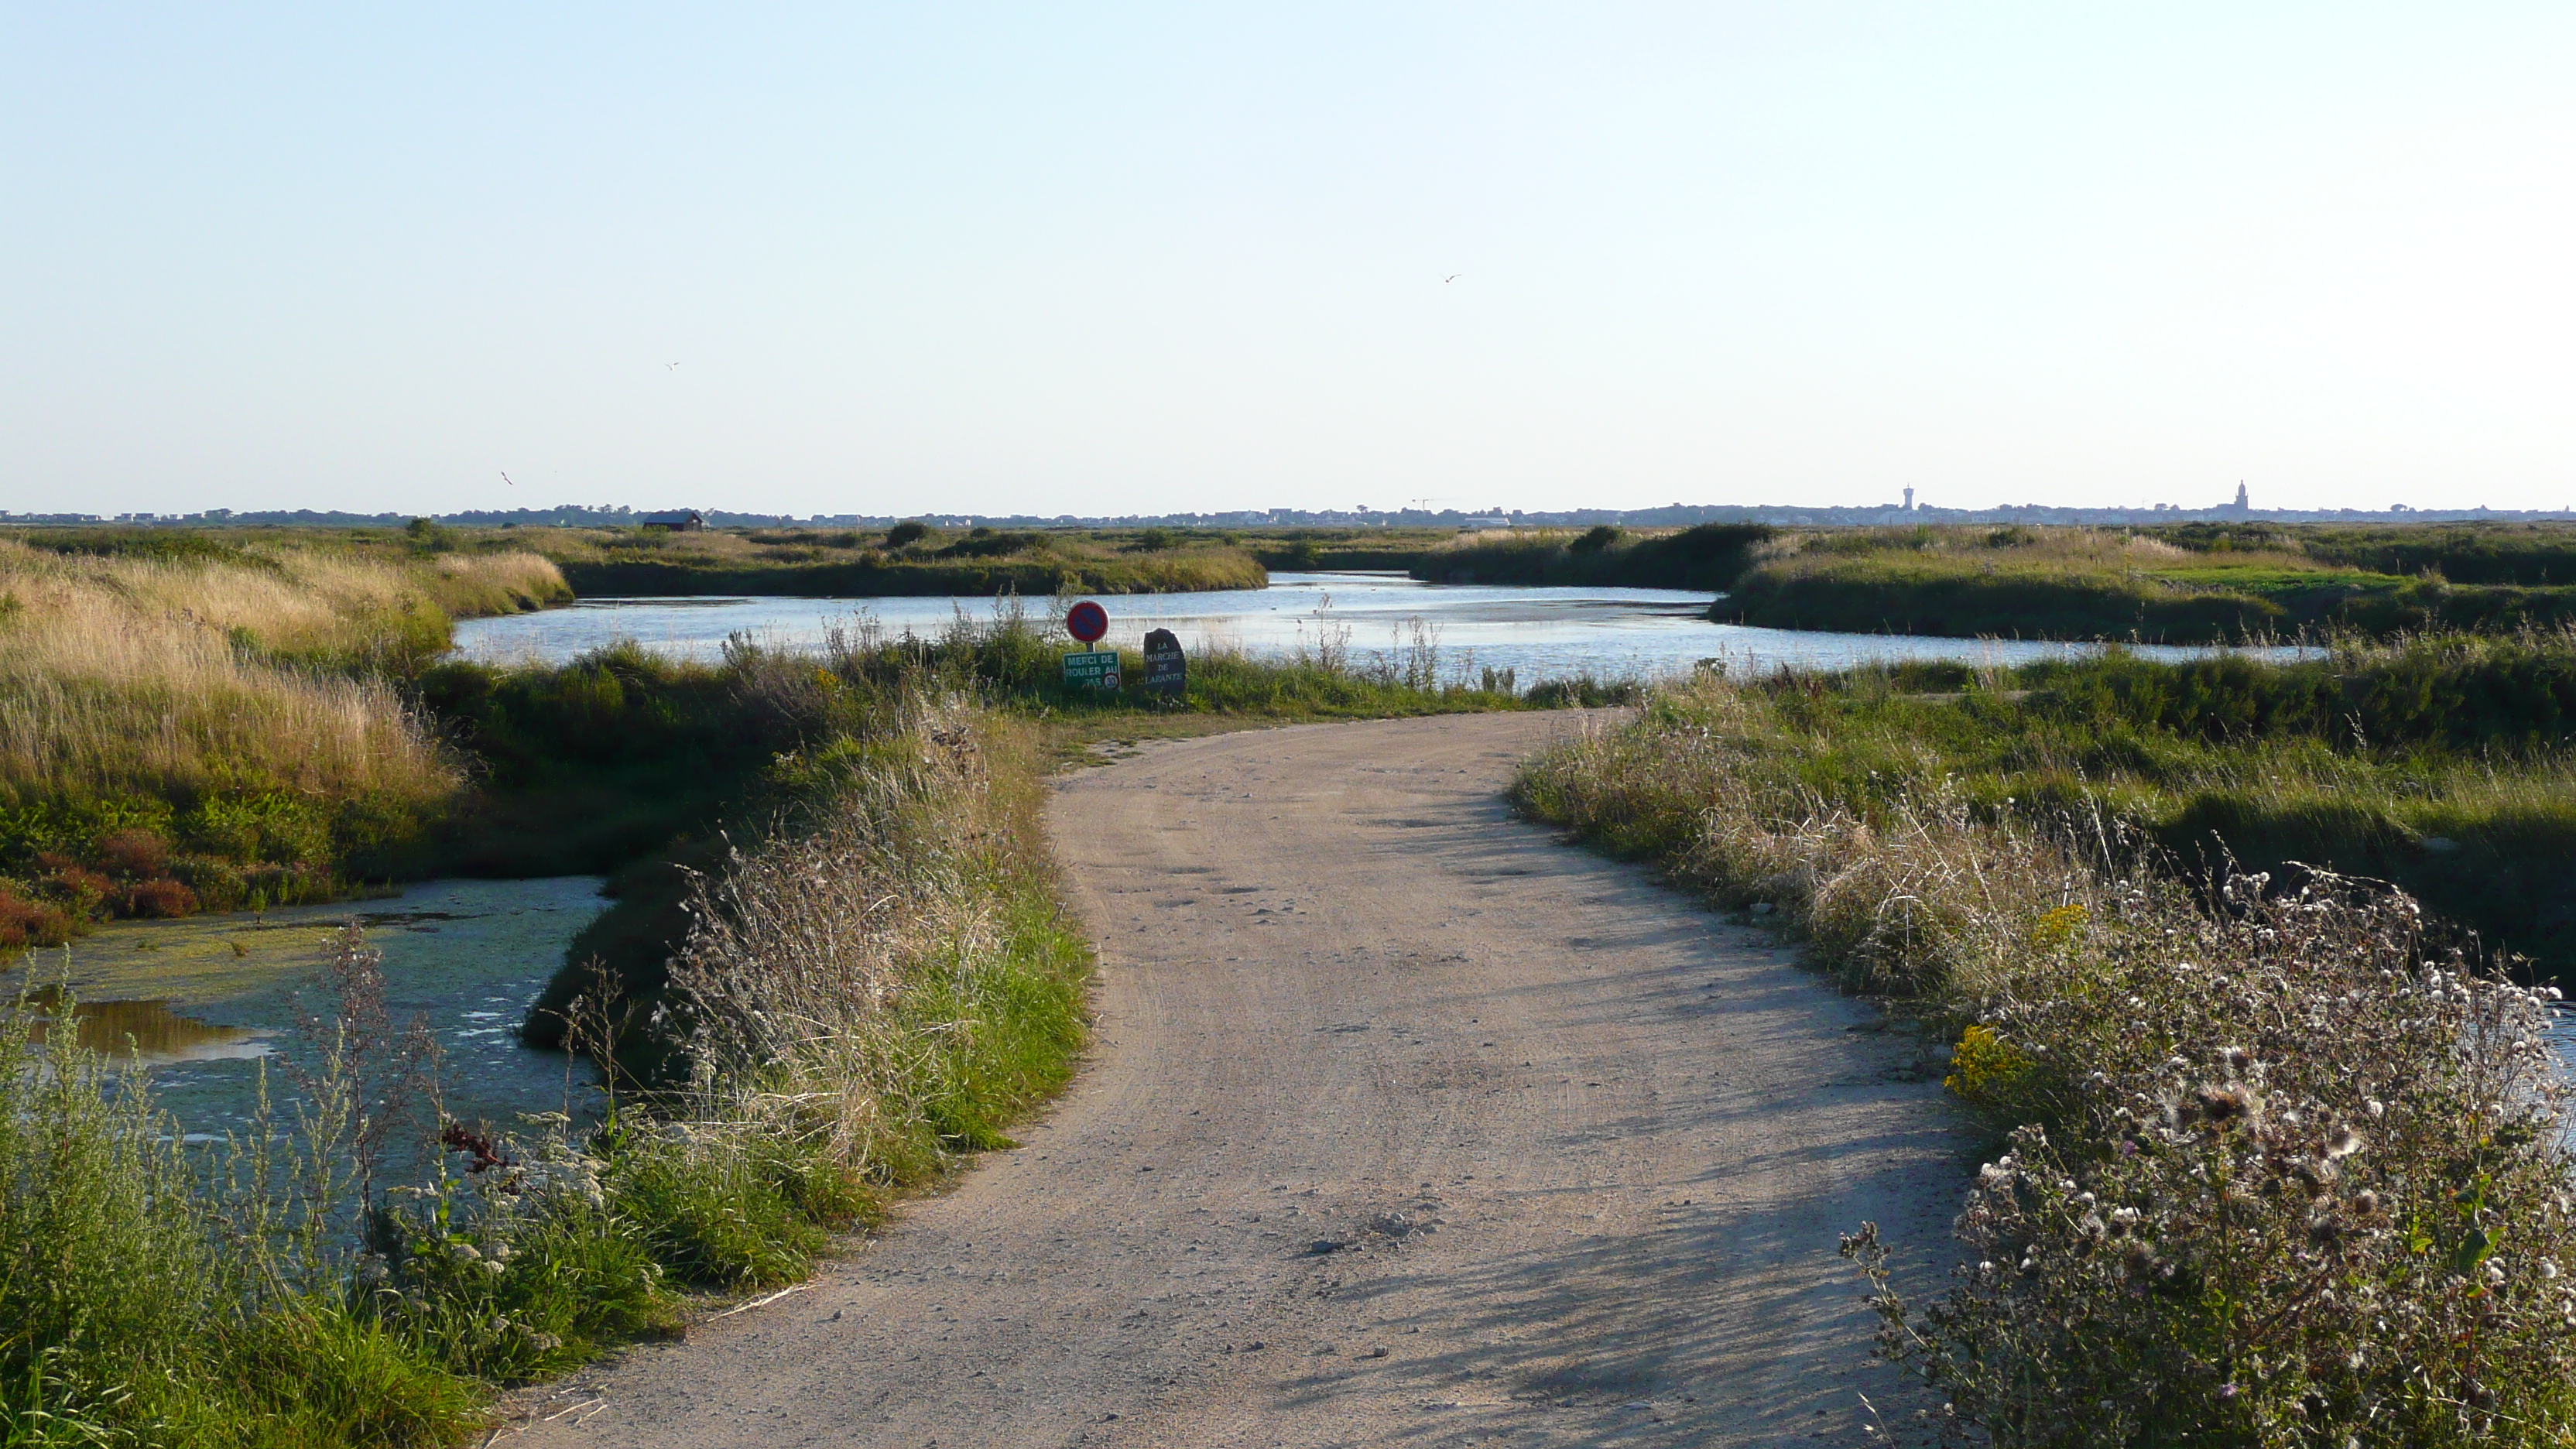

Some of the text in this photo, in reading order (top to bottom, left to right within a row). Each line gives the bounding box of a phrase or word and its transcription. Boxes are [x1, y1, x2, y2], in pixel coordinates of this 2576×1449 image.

[1157, 642, 1168, 650] LA
[1068, 655, 1114, 666] MERCI DE
[1146, 652, 1180, 663] MARCHE
[1066, 666, 1118, 677] ROULER AU
